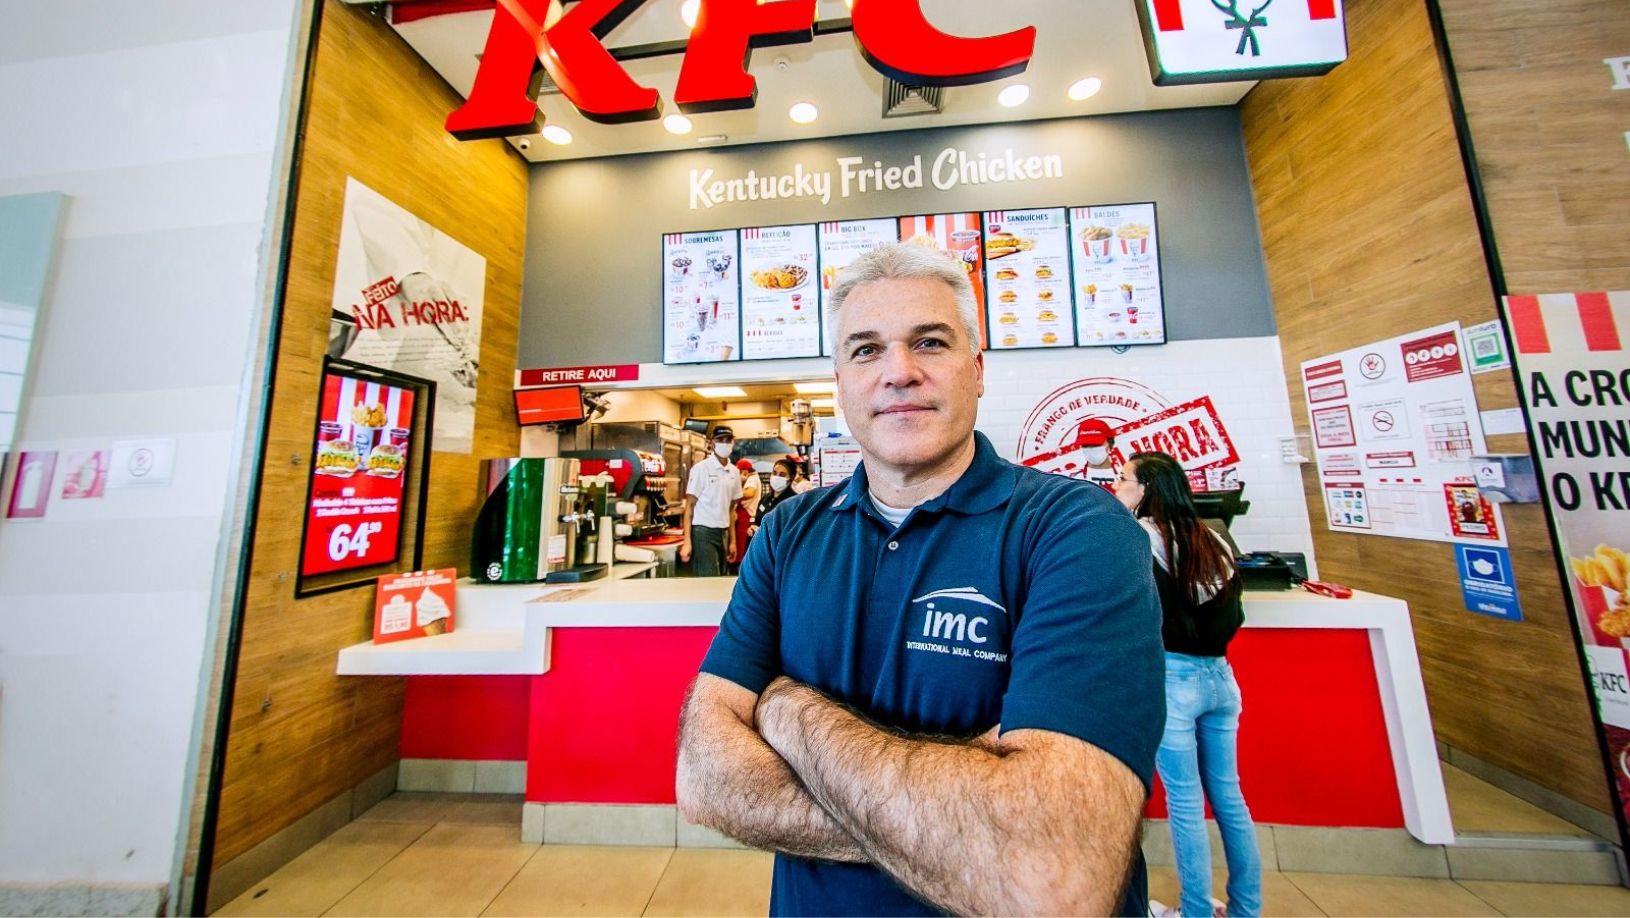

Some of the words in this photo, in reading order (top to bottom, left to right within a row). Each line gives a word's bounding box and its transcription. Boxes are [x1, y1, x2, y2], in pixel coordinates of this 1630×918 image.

[445, 0, 1036, 139] KFC
[689, 163, 831, 209] Kentucky
[836, 155, 923, 198] Fried
[931, 148, 1063, 191] Chicken
[1007, 213, 1049, 222] SANDUÍCHES
[684, 236, 724, 244] SOBREMESAS
[365, 281, 398, 306] FEITO
[352, 303, 395, 331] NA
[401, 300, 469, 326] HORA:
[542, 370, 584, 382] RETIRE
[588, 368, 616, 381] AQUI
[1531, 371, 1558, 407] A
[1035, 406, 1068, 445] FRANGO
[1538, 420, 1630, 459] MUN
[1552, 472, 1581, 511] O
[328, 523, 371, 562] 64
[923, 602, 988, 643] imc
[906, 641, 950, 654] INTERNATIONAL
[952, 646, 971, 657] MEAL
[974, 650, 1007, 662] COMPANY
[1600, 671, 1626, 694] KFC
